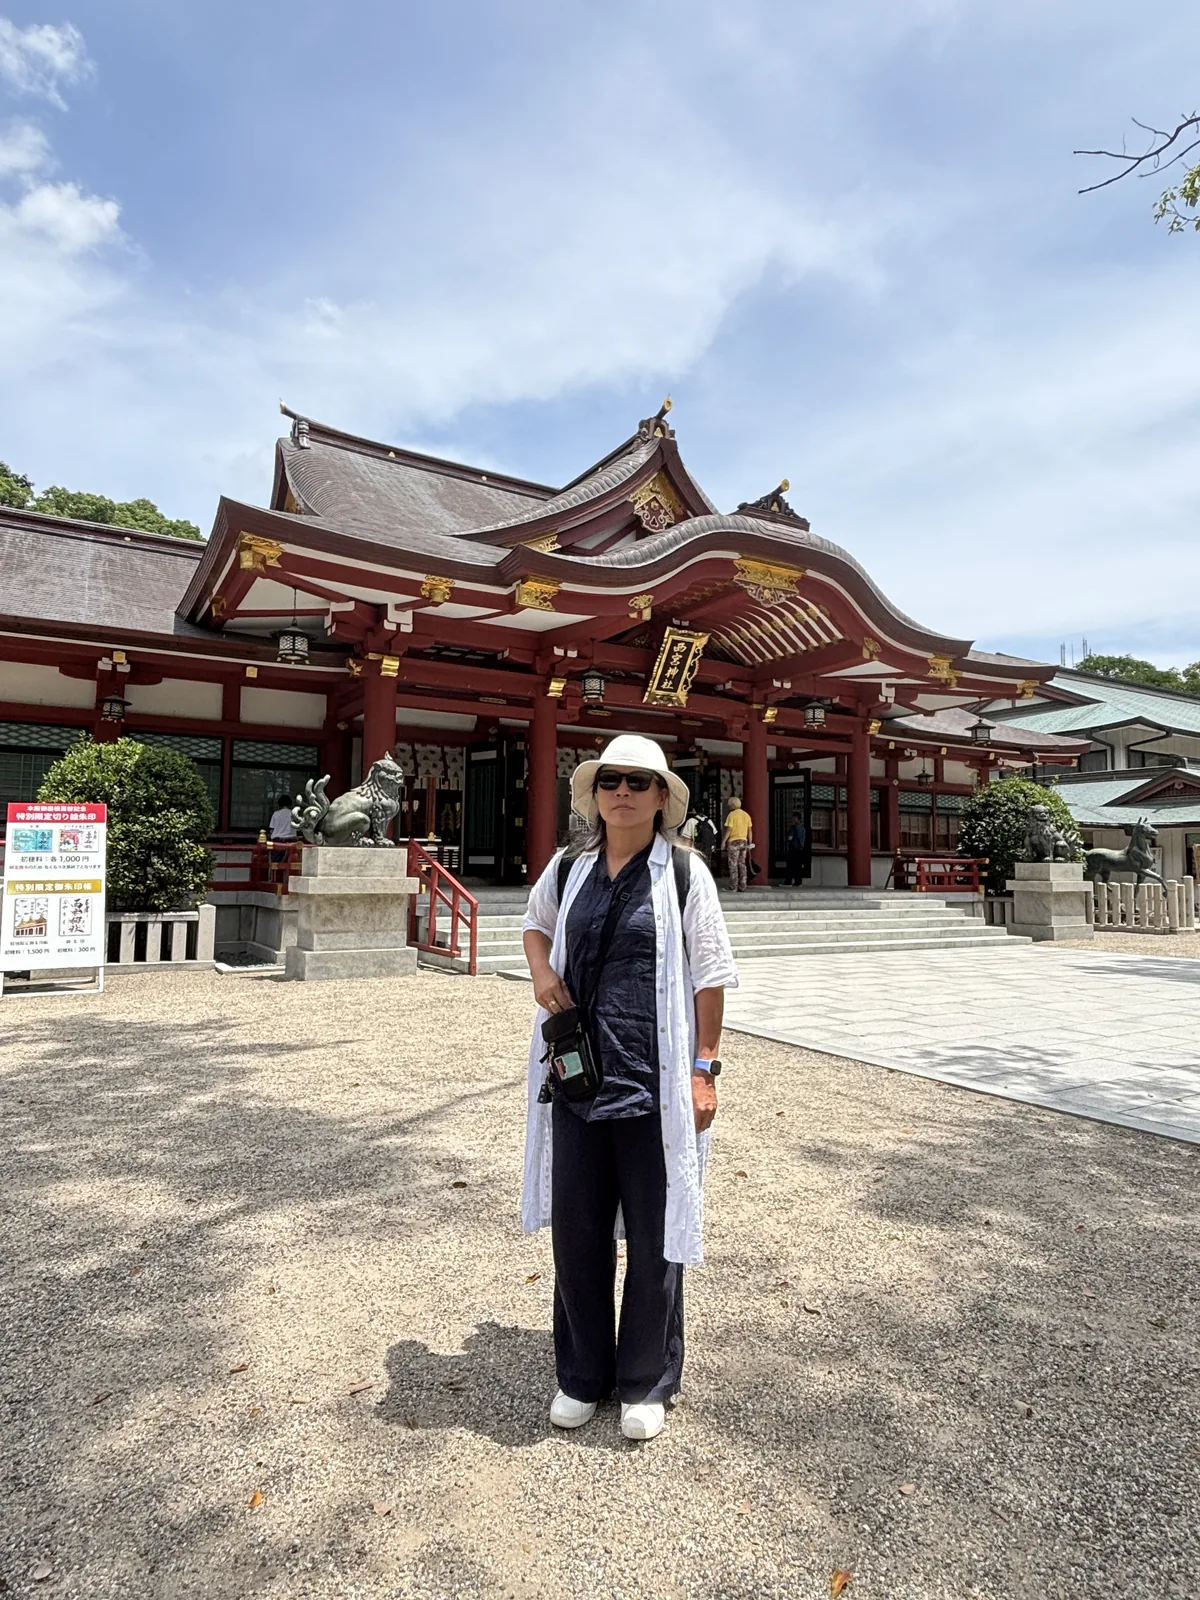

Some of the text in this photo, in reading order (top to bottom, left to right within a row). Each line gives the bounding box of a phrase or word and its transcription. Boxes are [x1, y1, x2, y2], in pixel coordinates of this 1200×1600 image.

[661, 642, 687, 689] 西宮神社
[15, 882, 92, 892] 特別限定御朱印帳
